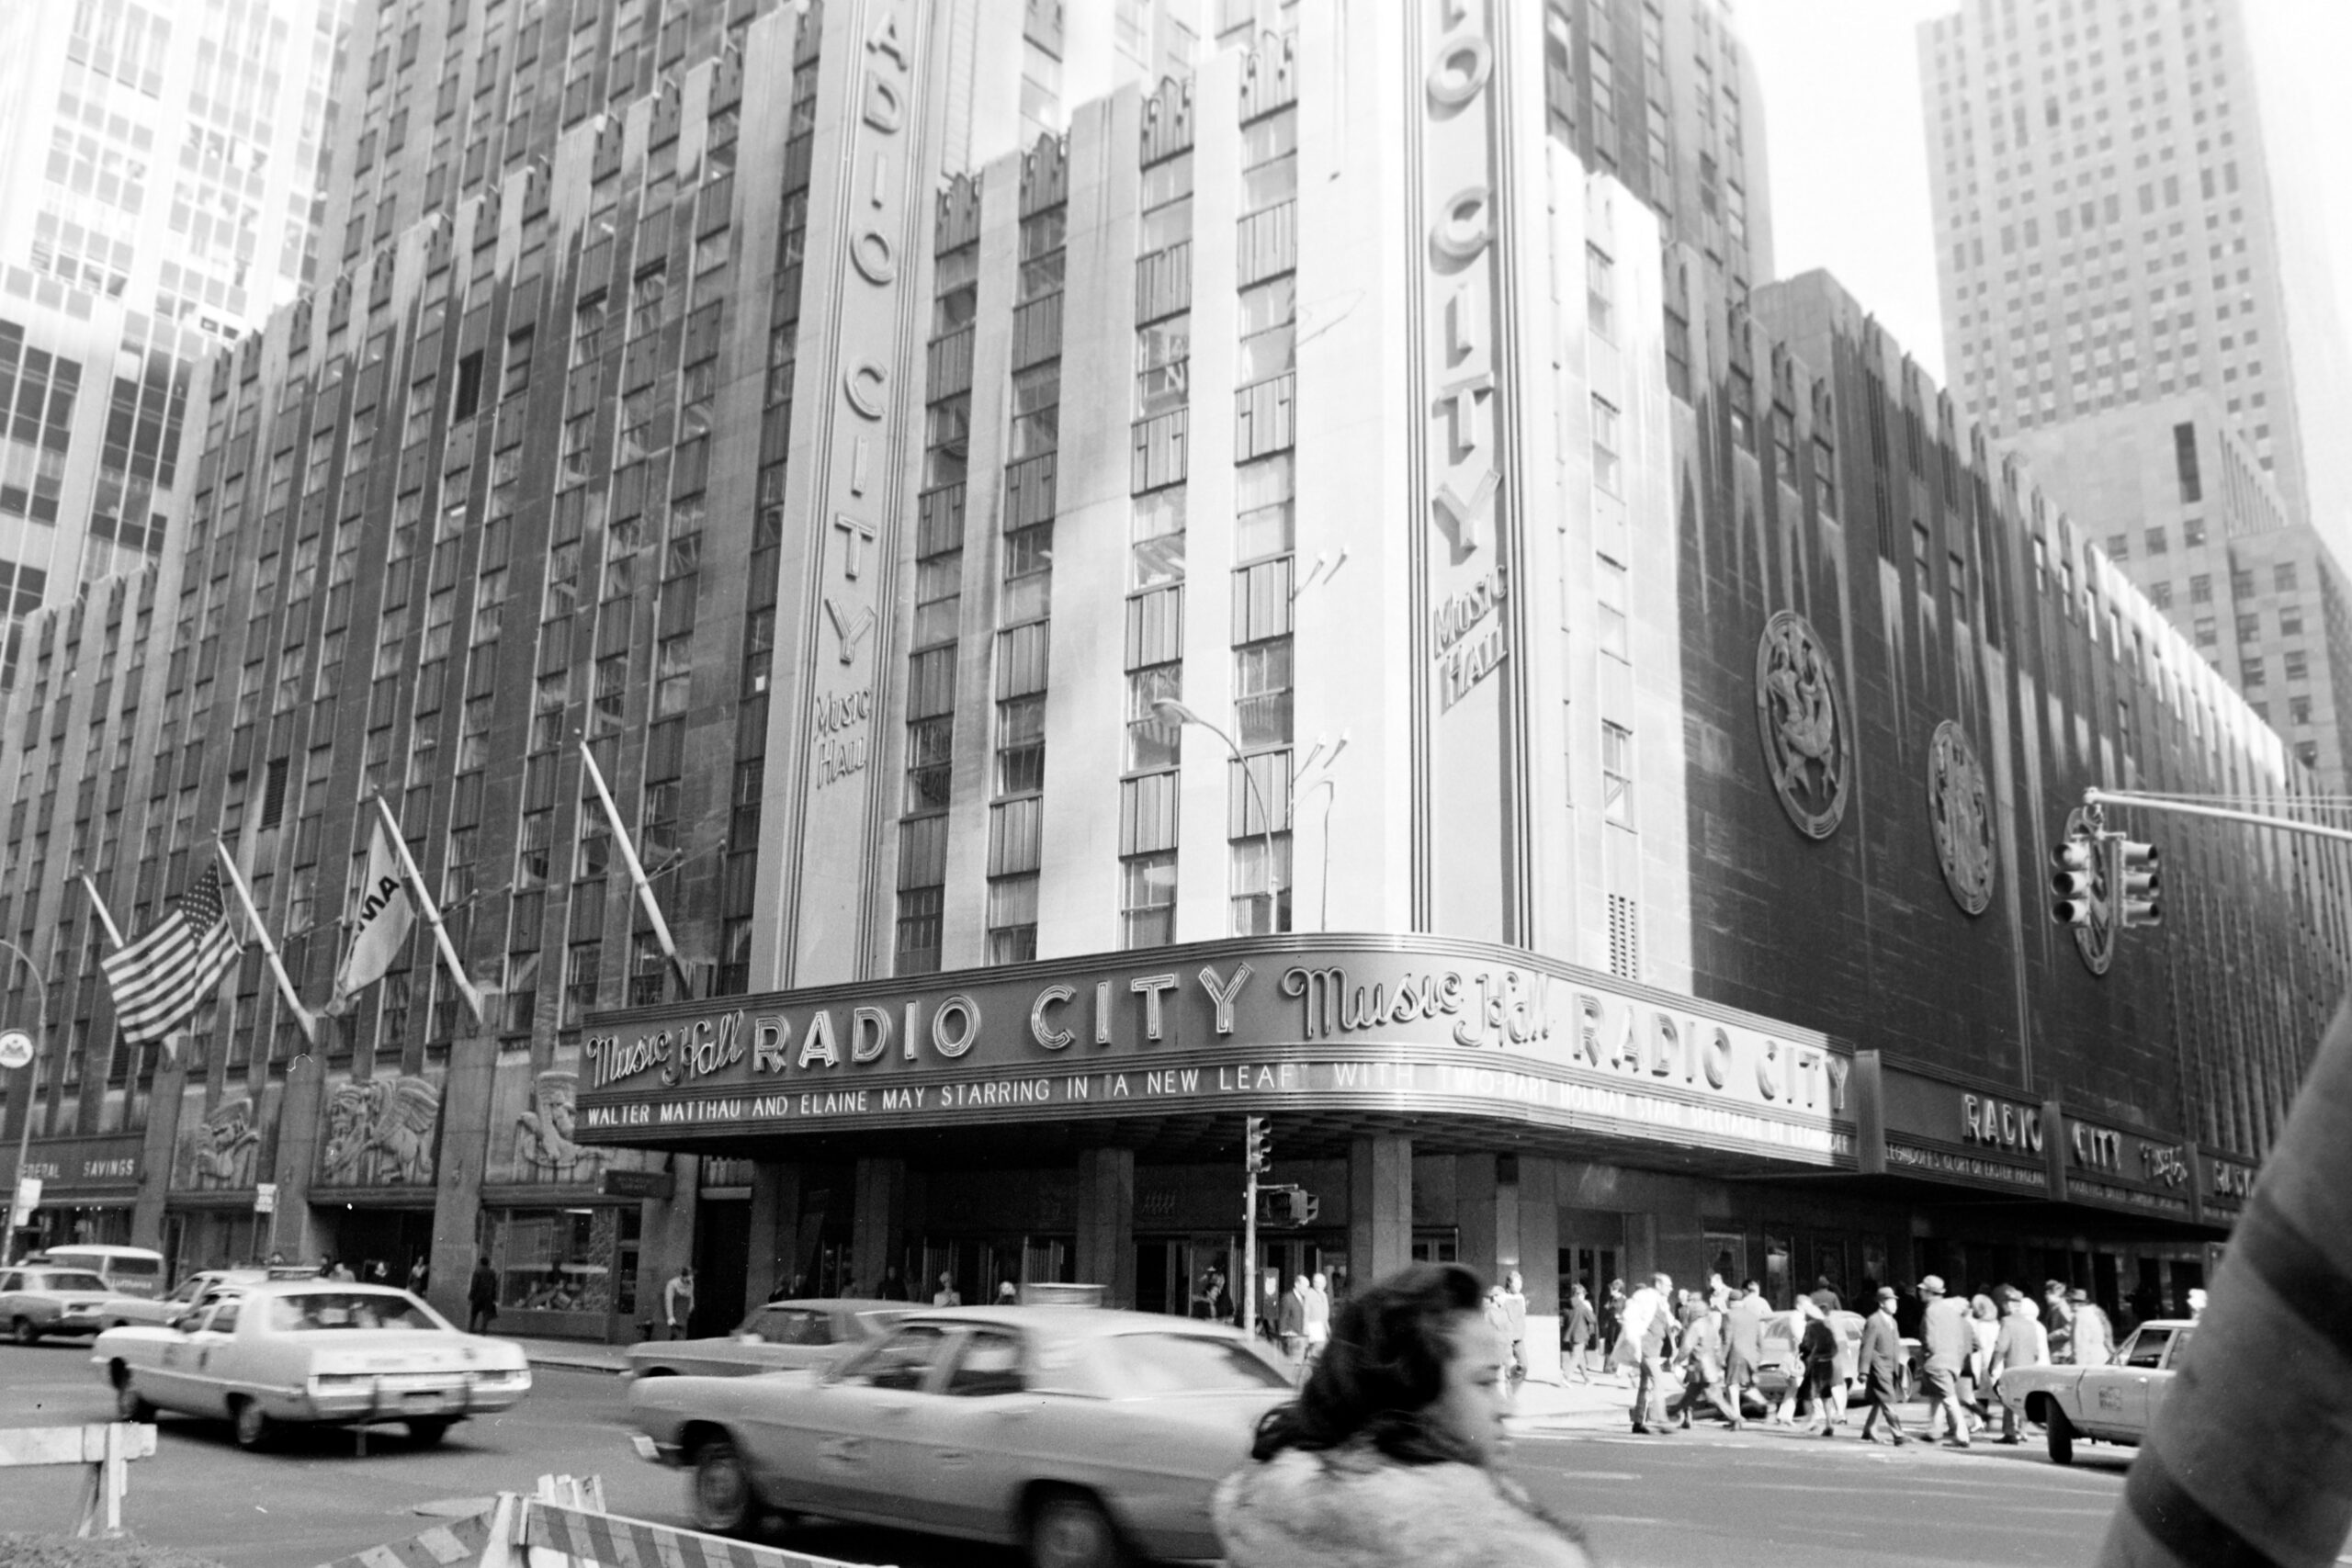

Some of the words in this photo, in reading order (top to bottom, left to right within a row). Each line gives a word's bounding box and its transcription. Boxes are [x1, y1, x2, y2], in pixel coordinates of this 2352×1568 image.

[1429, 186, 1503, 566] CITY
[824, 363, 888, 665] CITY
[586, 1030, 673, 1089] Music
[662, 1009, 747, 1087] Hall
[752, 993, 981, 1073] RADIO
[1031, 961, 1256, 1051] CITY
[1281, 966, 1464, 1040] Music
[1453, 970, 1554, 1047] Hall
[1572, 991, 1733, 1091] RADIO
[1755, 1039, 1849, 1113] CITY
[588, 1105, 650, 1126] WALTER
[660, 1099, 741, 1122] MATTHAU
[752, 1095, 788, 1117] AND
[800, 1090, 868, 1114] ELAINE
[882, 1087, 925, 1110] MAY
[941, 1078, 1050, 1107] STARRING
[1068, 1076, 1089, 1100] IN
[1148, 1068, 1199, 1094] NEW
[1333, 1063, 1414, 1088] WITH
[1437, 1065, 1549, 1101] TWO-PART
[1559, 1083, 1626, 1115] HOLIDAY
[22, 1163, 61, 1179] EDERAL
[83, 1158, 135, 1177] SAVINGS
[1961, 1092, 2043, 1152] RADIO
[2071, 1121, 2121, 1170] CITY
